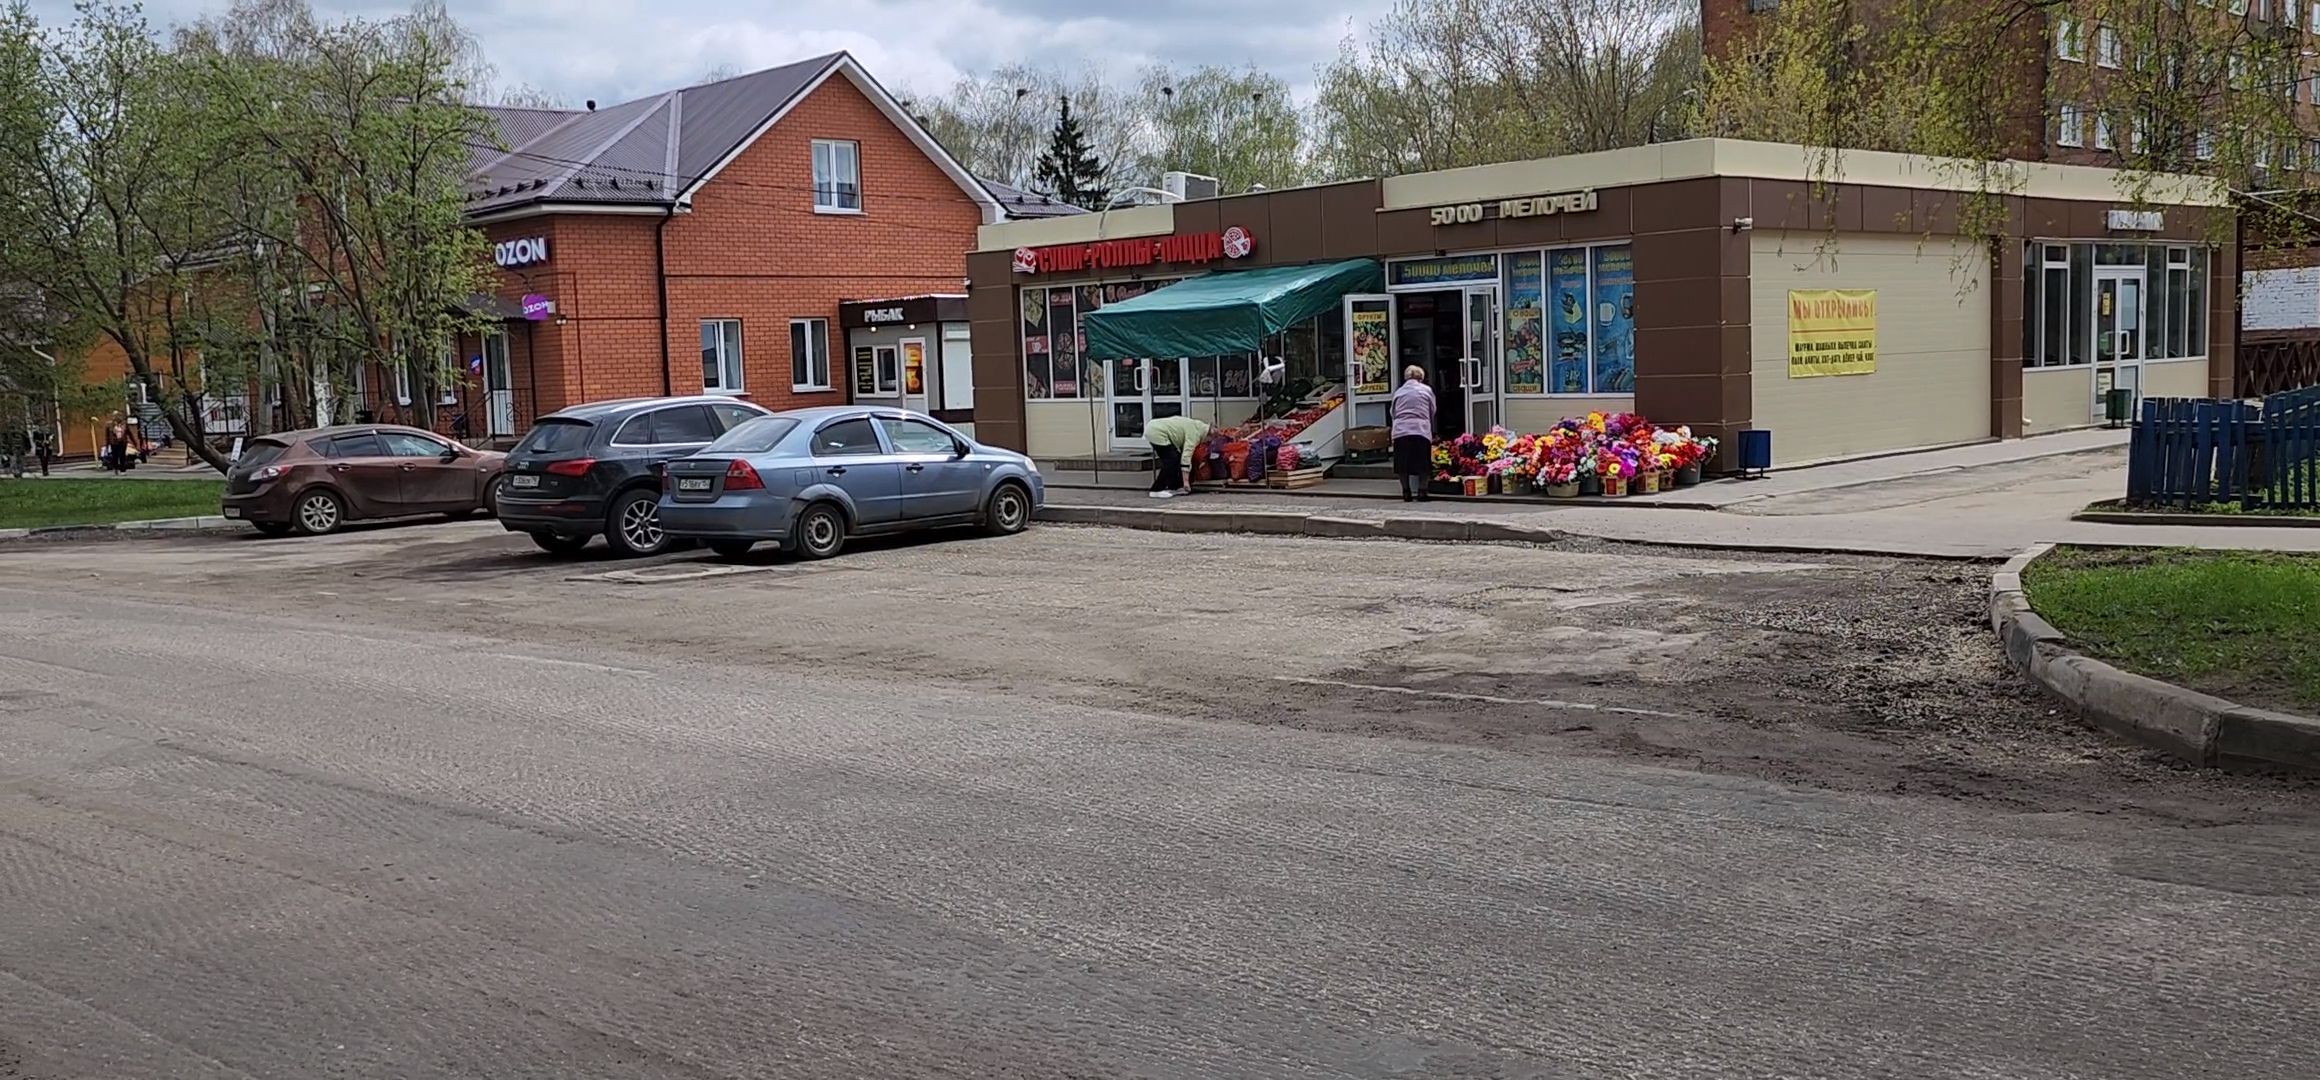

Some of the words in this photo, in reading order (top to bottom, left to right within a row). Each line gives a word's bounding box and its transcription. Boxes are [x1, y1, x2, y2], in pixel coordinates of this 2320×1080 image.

[1500, 188, 1598, 218] МЕЛОЧЕЙ
[495, 237, 546, 267] OZON
[1038, 248, 1084, 274] СУШИ
[1092, 239, 1154, 269] РОЛЛЫ
[1161, 232, 1223, 265] ПИЦЦА
[523, 301, 549, 314] OZON
[864, 308, 904, 322] РЫБАК
[1793, 299, 1811, 321] МЫ
[1814, 299, 1873, 319] ОТКРЫЛИСЬ!
